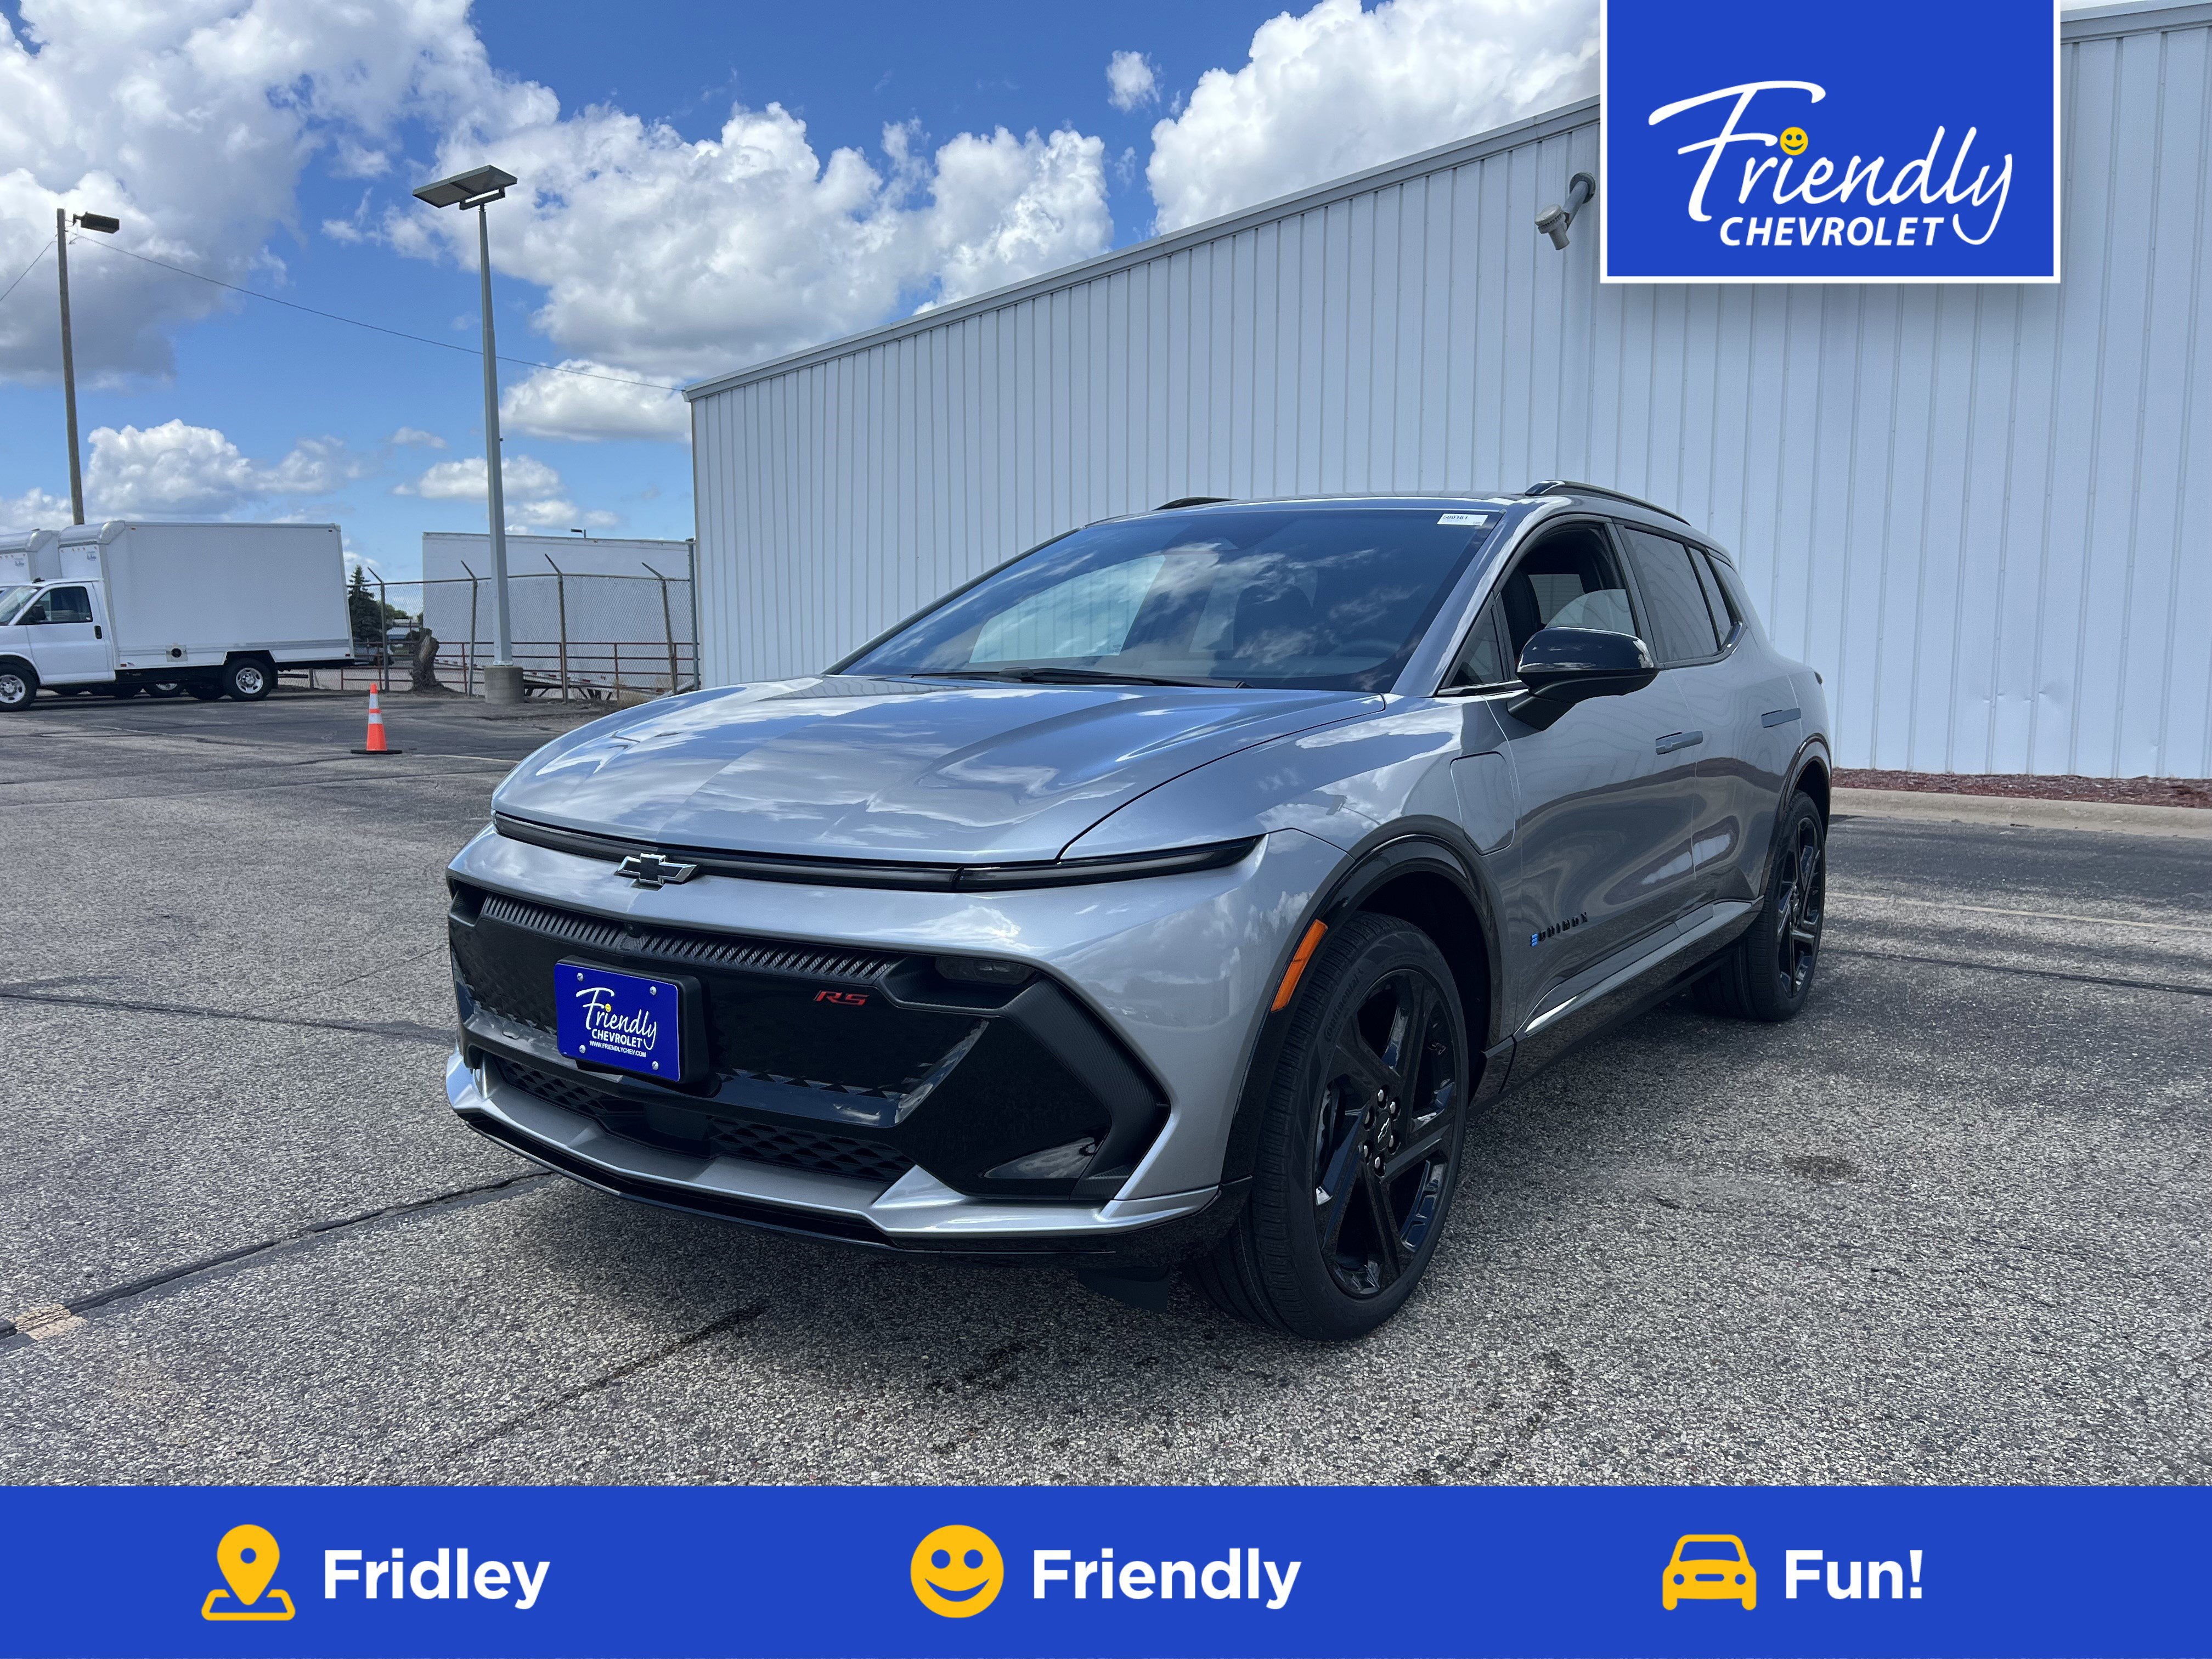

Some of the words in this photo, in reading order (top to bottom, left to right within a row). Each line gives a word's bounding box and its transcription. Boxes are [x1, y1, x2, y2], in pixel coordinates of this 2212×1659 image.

[813, 990, 870, 1006] RS
[576, 988, 657, 1050] Friendly
[591, 1028, 642, 1048] CHEVROLET
[589, 1040, 647, 1058] WWW.FRIENDLYCHEV.COM
